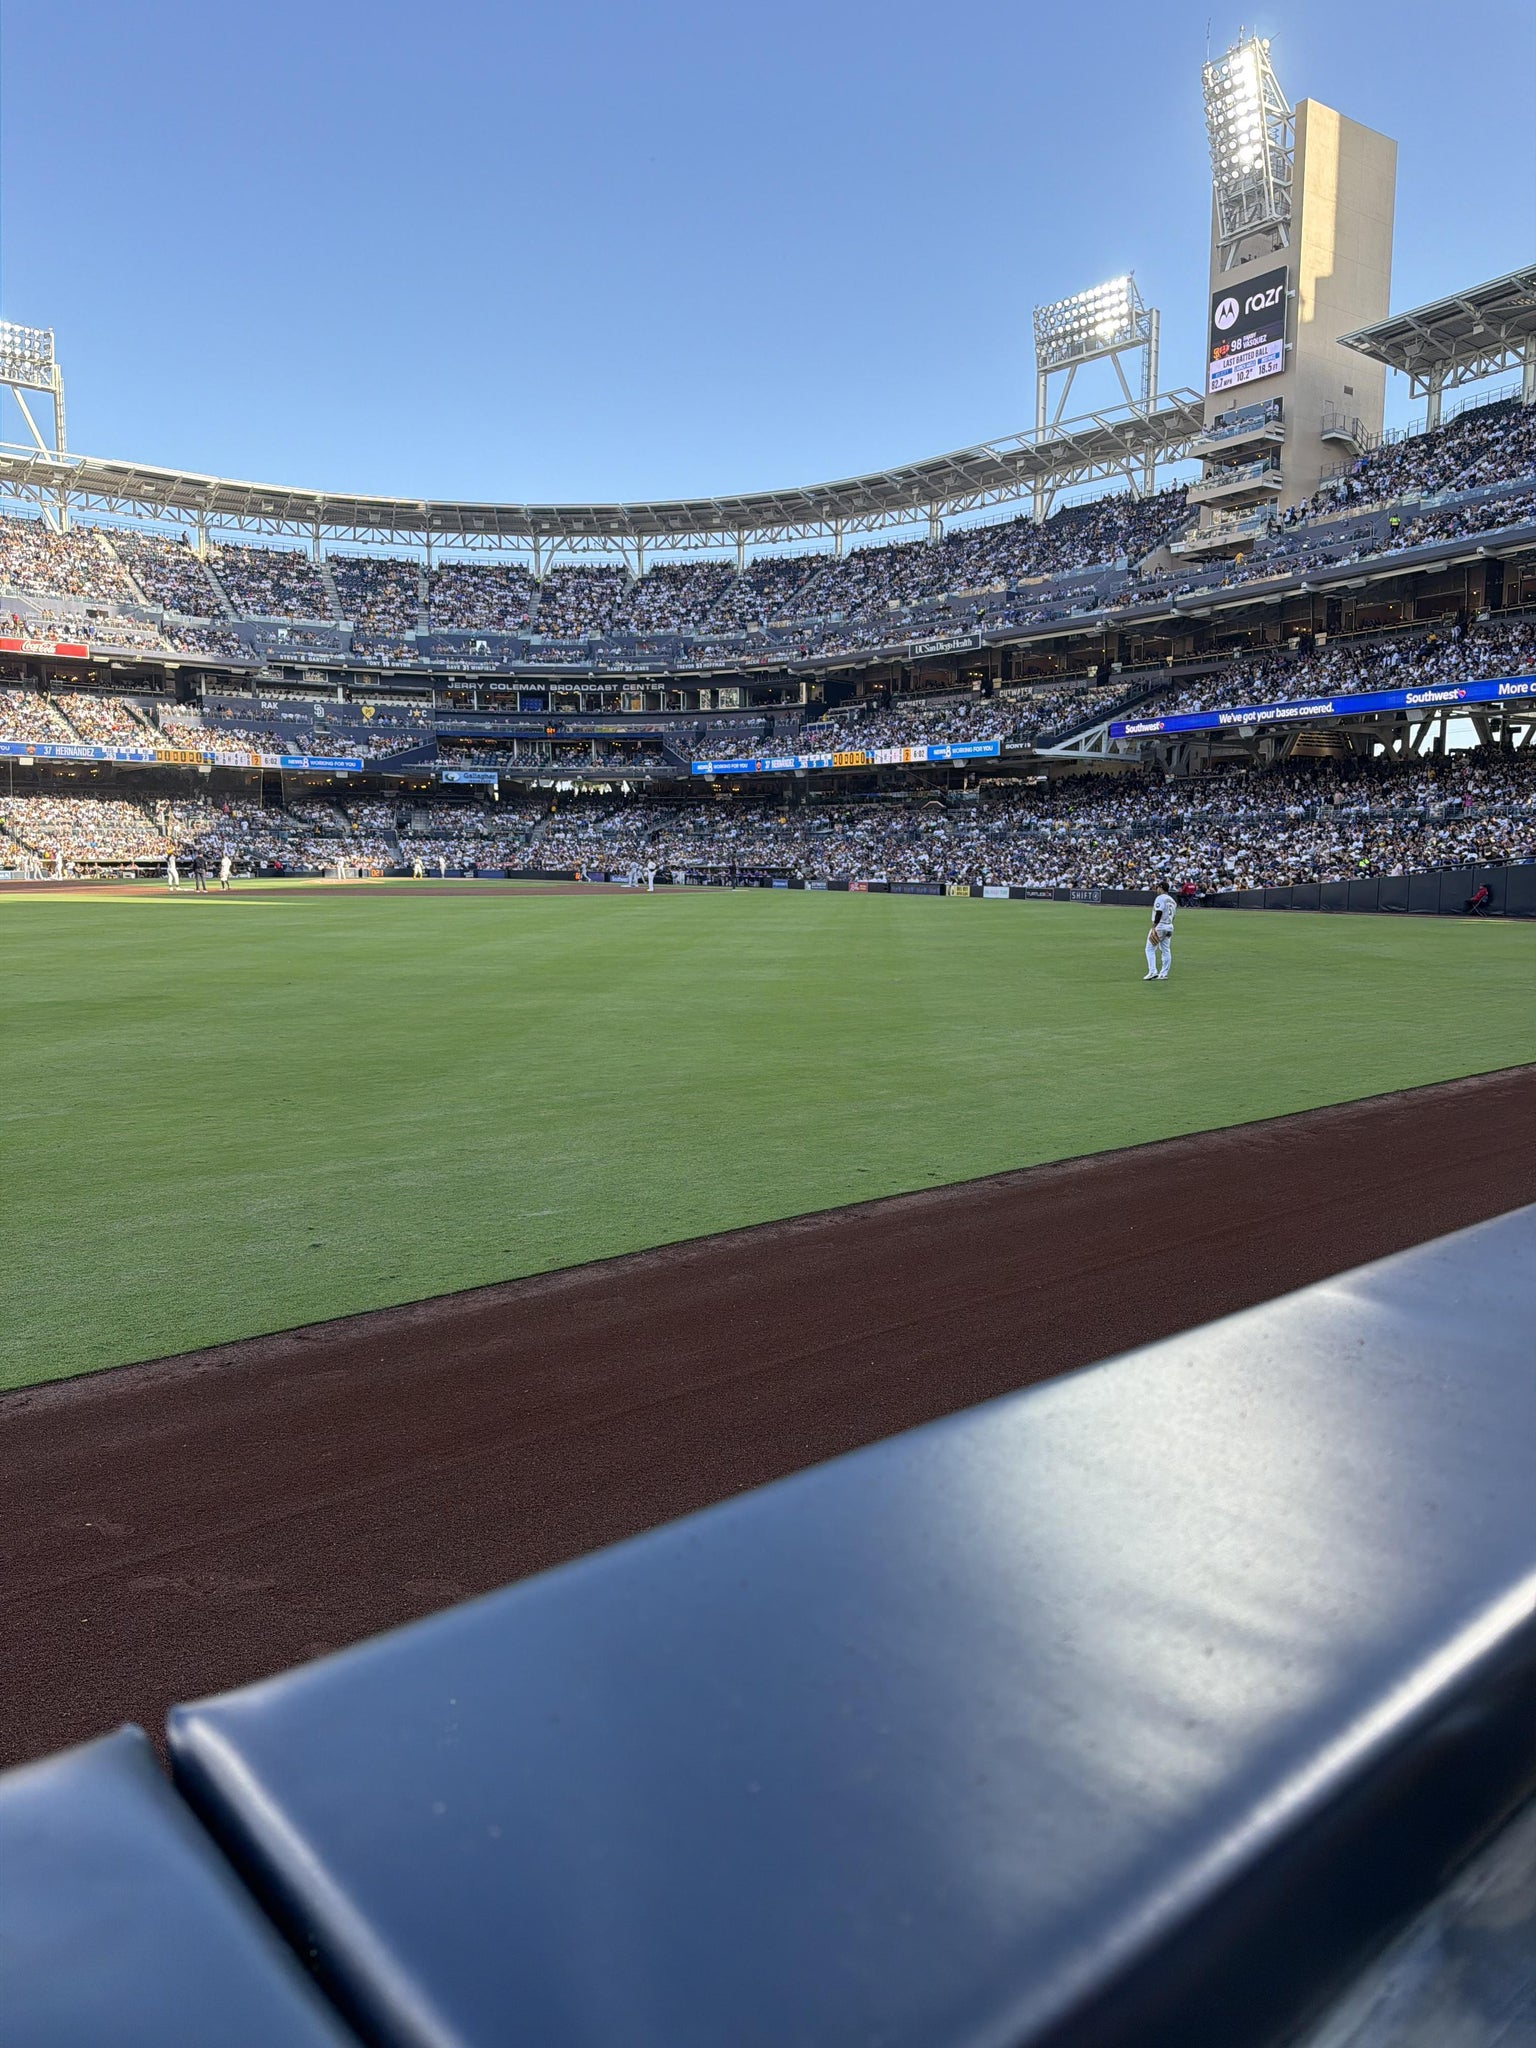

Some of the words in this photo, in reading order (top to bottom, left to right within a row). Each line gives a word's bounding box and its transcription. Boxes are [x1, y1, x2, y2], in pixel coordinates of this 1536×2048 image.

[1245, 285, 1283, 314] razr
[1231, 338, 1242, 352] 98
[1223, 359, 1235, 368] LAST
[1236, 352, 1254, 365] BATTED
[1255, 347, 1268, 358] BALL
[1259, 362, 1273, 375] 18.5
[915, 645, 924, 654] UC
[924, 644, 936, 653] San
[936, 641, 953, 652] Diego
[953, 638, 973, 649] Health
[489, 683, 545, 691] COLEMAN
[622, 683, 665, 691] CENTER
[1498, 683, 1528, 695] More
[1406, 689, 1459, 704] Southwest
[261, 701, 278, 709] RAK
[1219, 712, 1242, 724] We've
[1243, 711, 1256, 724] got
[1256, 709, 1275, 722] your
[1276, 707, 1298, 718] bases
[1299, 702, 1335, 715] covered.
[1125, 722, 1159, 734] Southwest
[43, 746, 52, 755] 37
[1071, 891, 1092, 900] SHIFT
